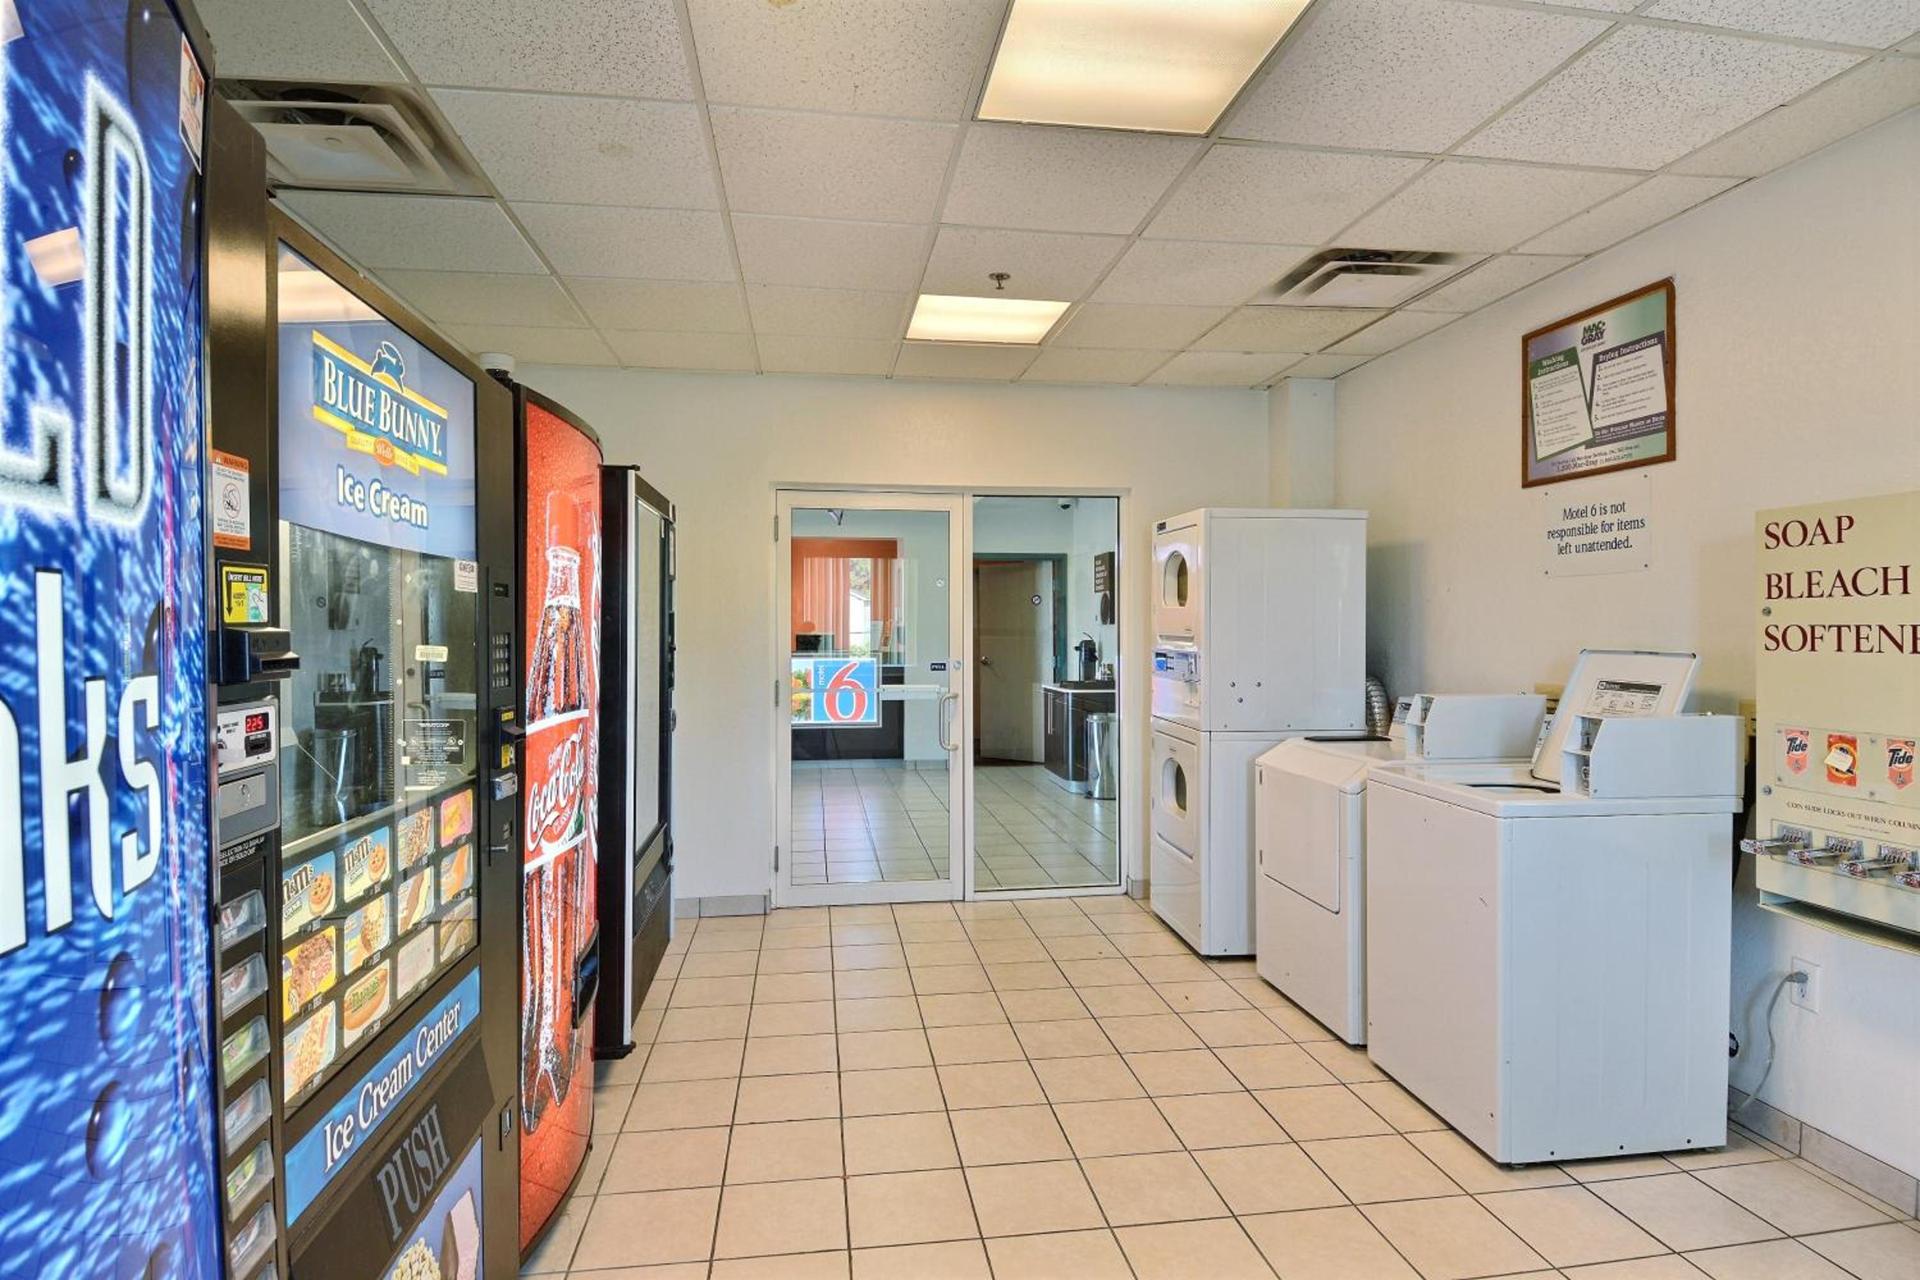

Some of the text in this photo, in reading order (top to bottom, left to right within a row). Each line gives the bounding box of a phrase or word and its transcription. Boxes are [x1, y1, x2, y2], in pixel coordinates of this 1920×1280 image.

[323, 355, 376, 427] BLUE
[337, 465, 429, 529] Ice Cream
[1563, 501, 1626, 520] Motel 6 is not
[1547, 518, 1646, 541] responsible for items
[1557, 535, 1633, 555] left unattended.
[1764, 515, 1855, 550] SOAP
[1765, 565, 1912, 600] BLEACH
[824, 661, 868, 722] 6
[1786, 737, 1808, 755] Tide
[1888, 748, 1914, 767] Tide
[1786, 802, 1803, 811] COIN
[1823, 807, 1846, 818] LOCKS
[1847, 812, 1862, 821] OUT
[1864, 815, 1886, 825] WHEN
[323, 1118, 355, 1173] Ice
[358, 1052, 412, 1129] Cream
[415, 1001, 461, 1068] Center
[376, 1103, 450, 1242] PUSH
